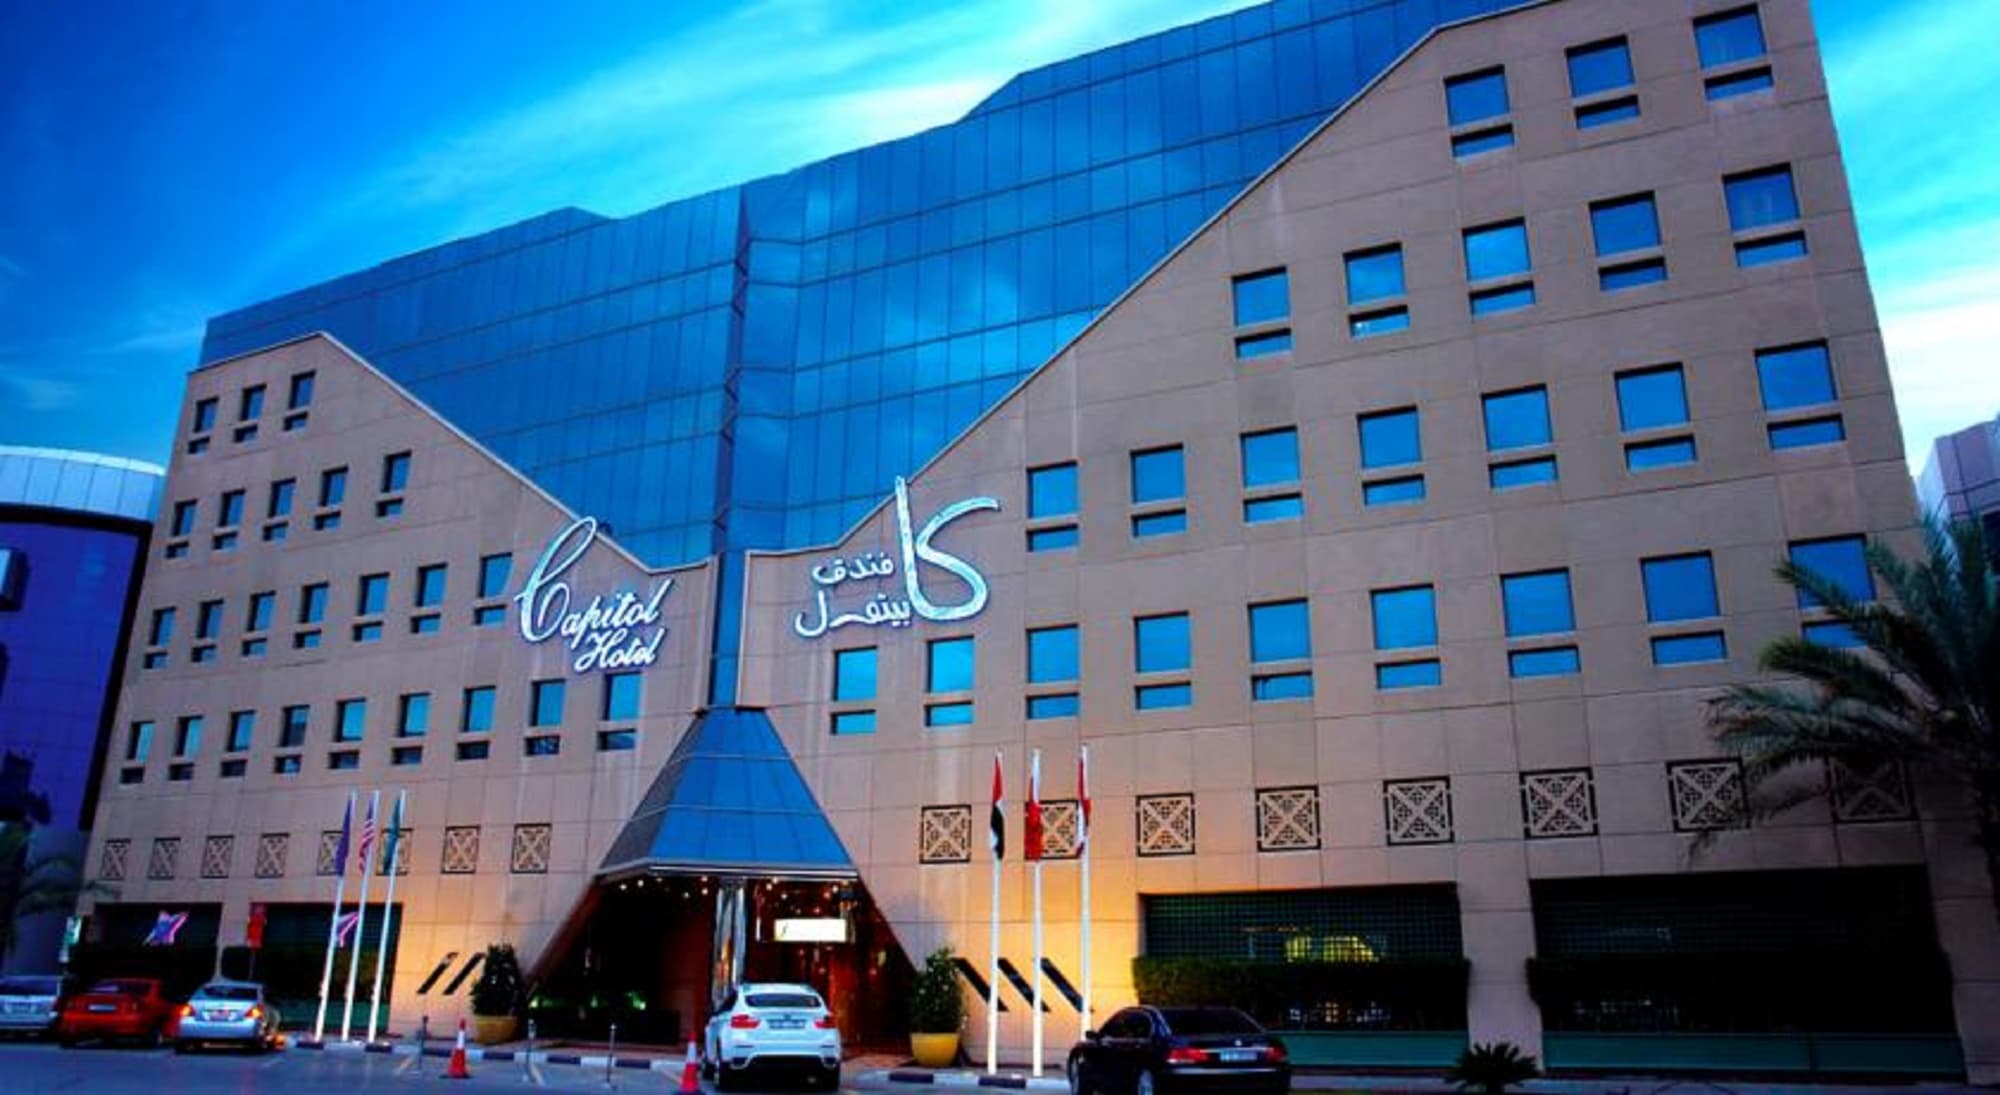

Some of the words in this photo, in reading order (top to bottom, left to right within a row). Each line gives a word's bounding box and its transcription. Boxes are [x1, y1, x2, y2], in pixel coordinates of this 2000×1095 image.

[513, 516, 673, 649] Capitol
[812, 552, 894, 584] فندق
[574, 628, 665, 672] Hotel
